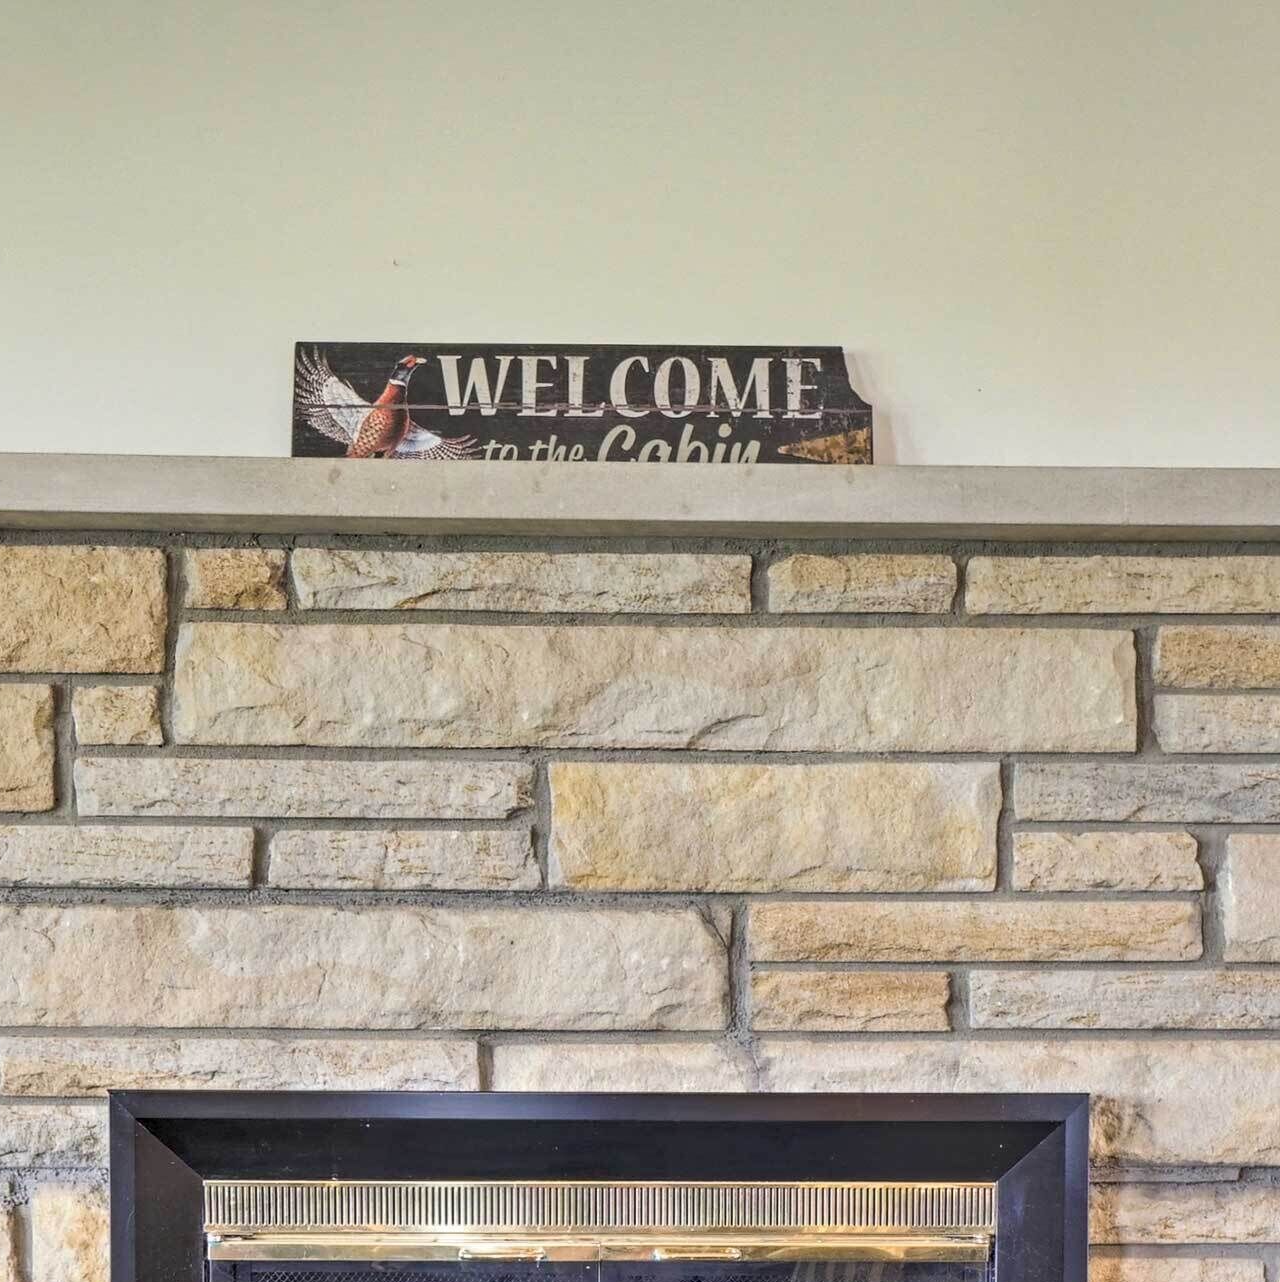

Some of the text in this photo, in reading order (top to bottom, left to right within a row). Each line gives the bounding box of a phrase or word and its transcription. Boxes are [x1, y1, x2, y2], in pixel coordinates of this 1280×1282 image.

[436, 354, 822, 419] WELCOME
[482, 423, 761, 463] to the Cabin
